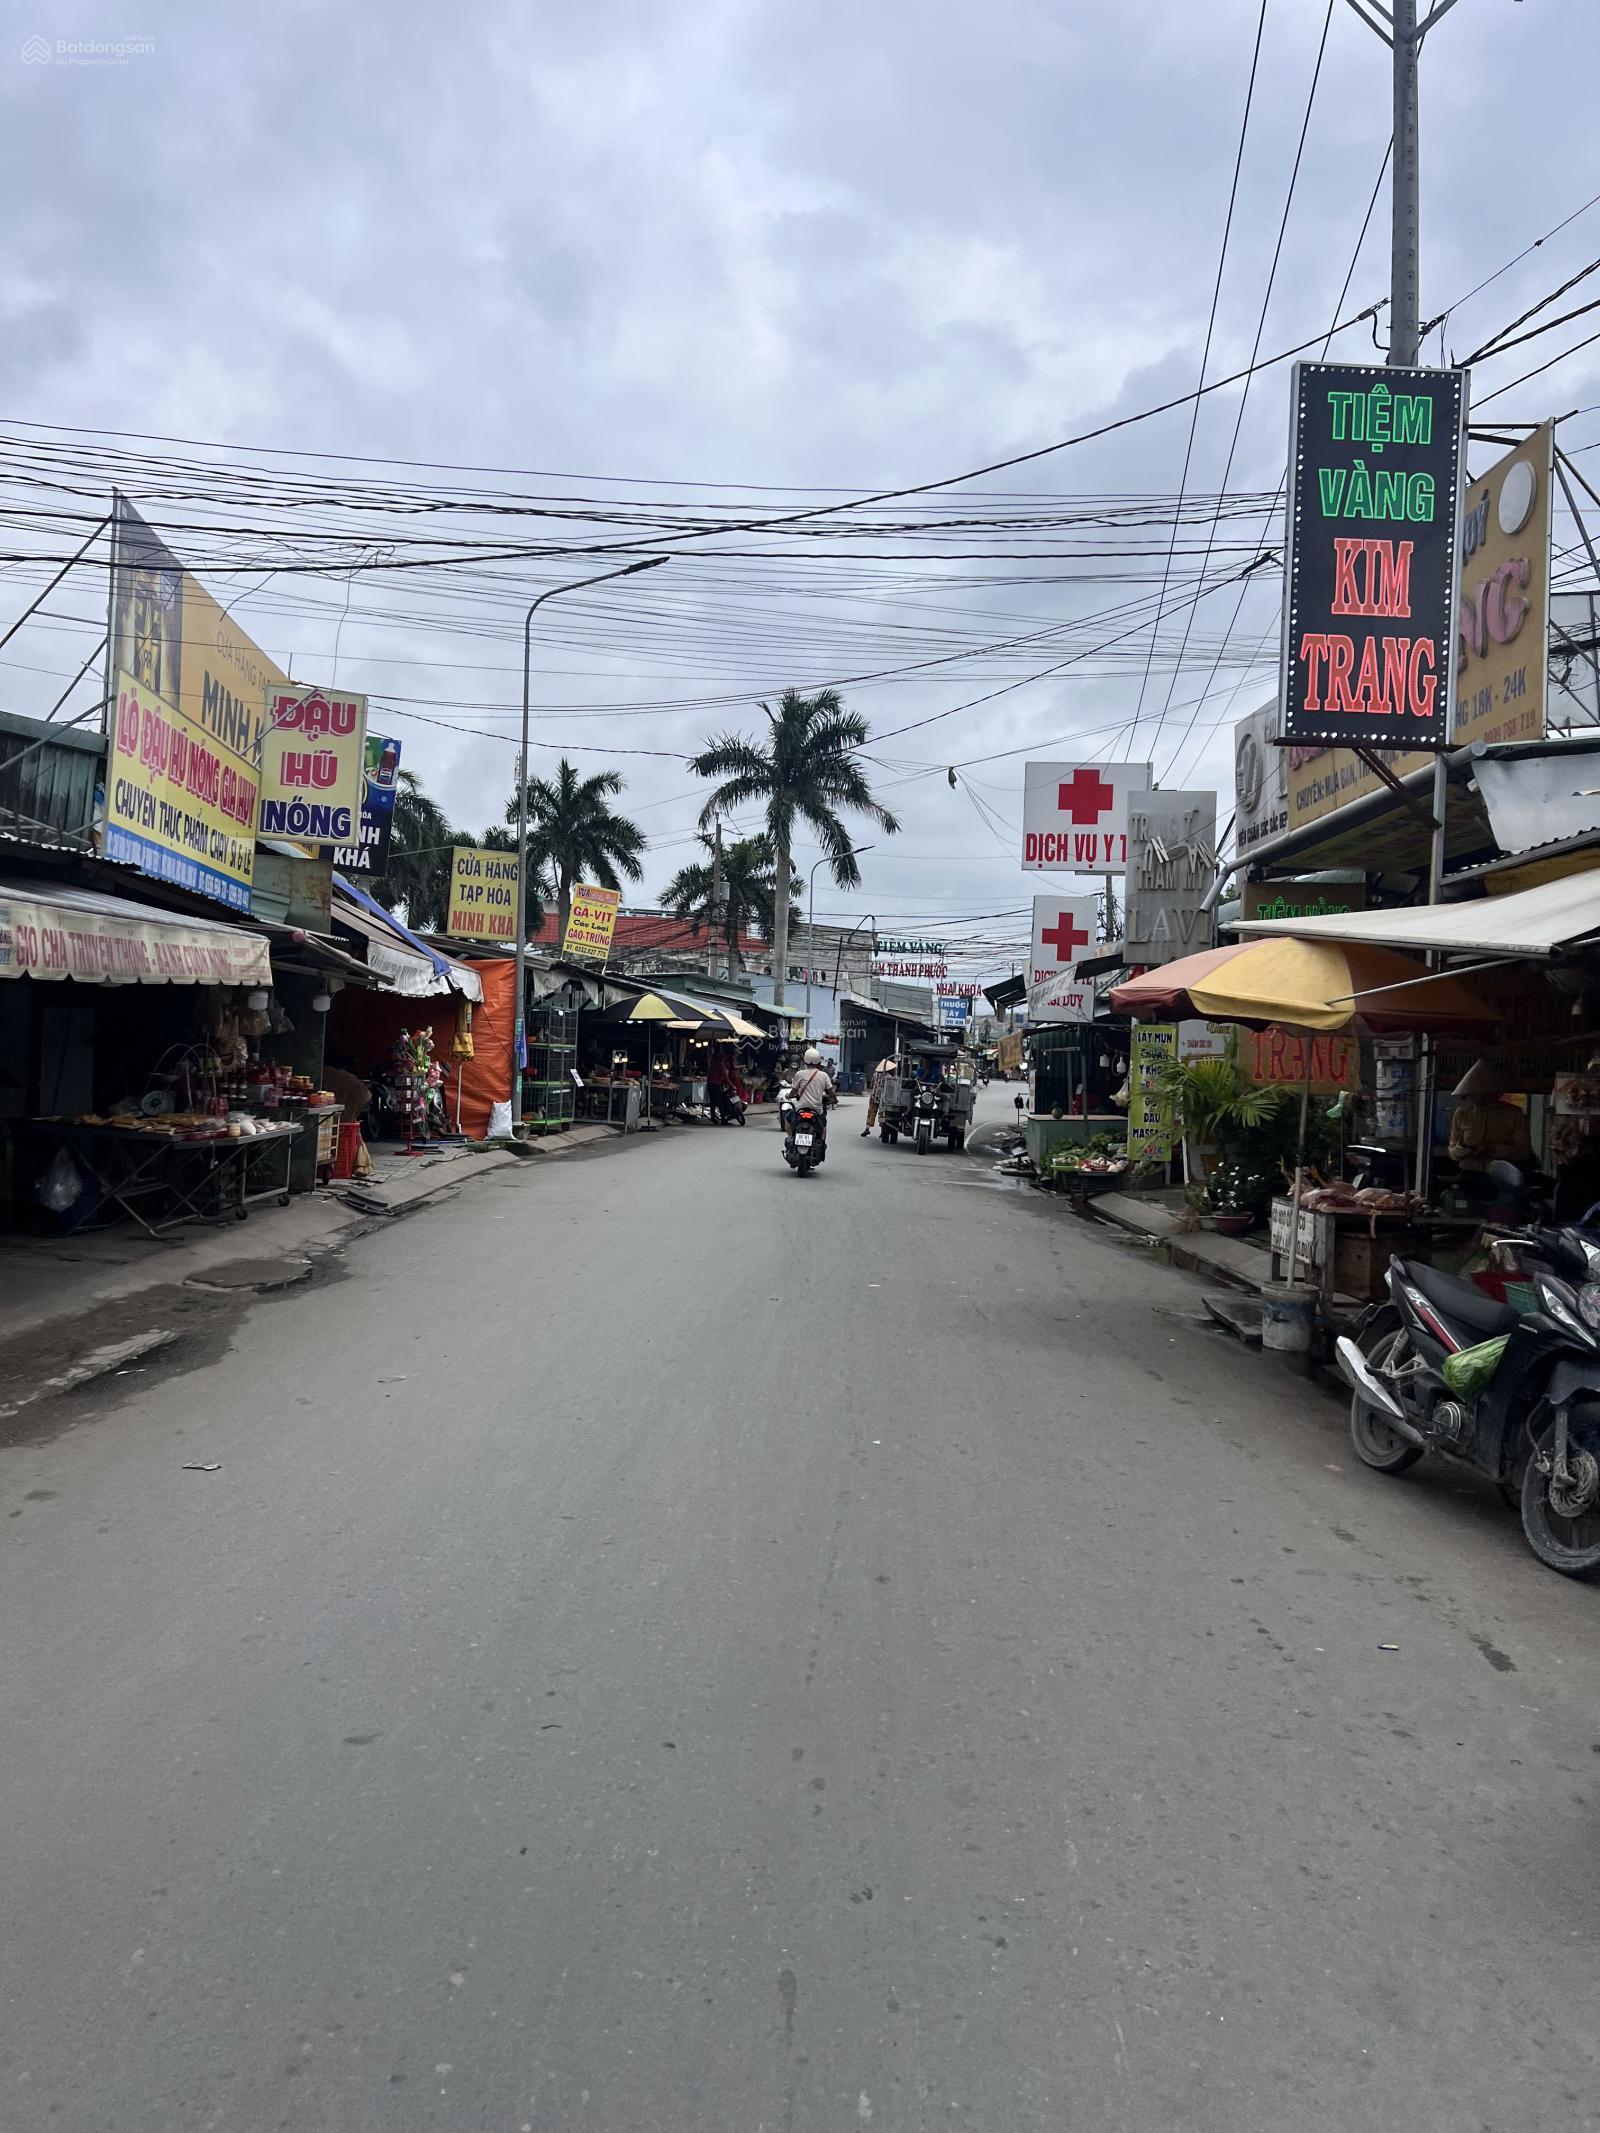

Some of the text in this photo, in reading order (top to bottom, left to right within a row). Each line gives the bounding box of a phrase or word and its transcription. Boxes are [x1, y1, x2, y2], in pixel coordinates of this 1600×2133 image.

[1328, 384, 1432, 452] TIỆM
[1318, 460, 1435, 522] VÀNG
[1331, 538, 1414, 618] KIM
[1300, 633, 1437, 716] TRANG
[1504, 666, 1526, 704] 24K
[202, 670, 252, 758] MINH
[270, 692, 356, 741] ĐẬU
[280, 750, 337, 789] HŨ
[260, 795, 351, 840] NÓNG
[333, 846, 371, 869] KHÁ
[457, 853, 518, 882] CỬA HÀNG
[1026, 833, 1068, 868] DỊCH
[1075, 834, 1097, 869] VỤ
[1105, 834, 1114, 862] Y
[460, 883, 511, 906] TẠP HÓA
[452, 911, 513, 936] MINH KHÁ
[573, 919, 590, 928] Các
[1128, 907, 1210, 944] LAVI
[1251, 1026, 1348, 1083] TRANG
